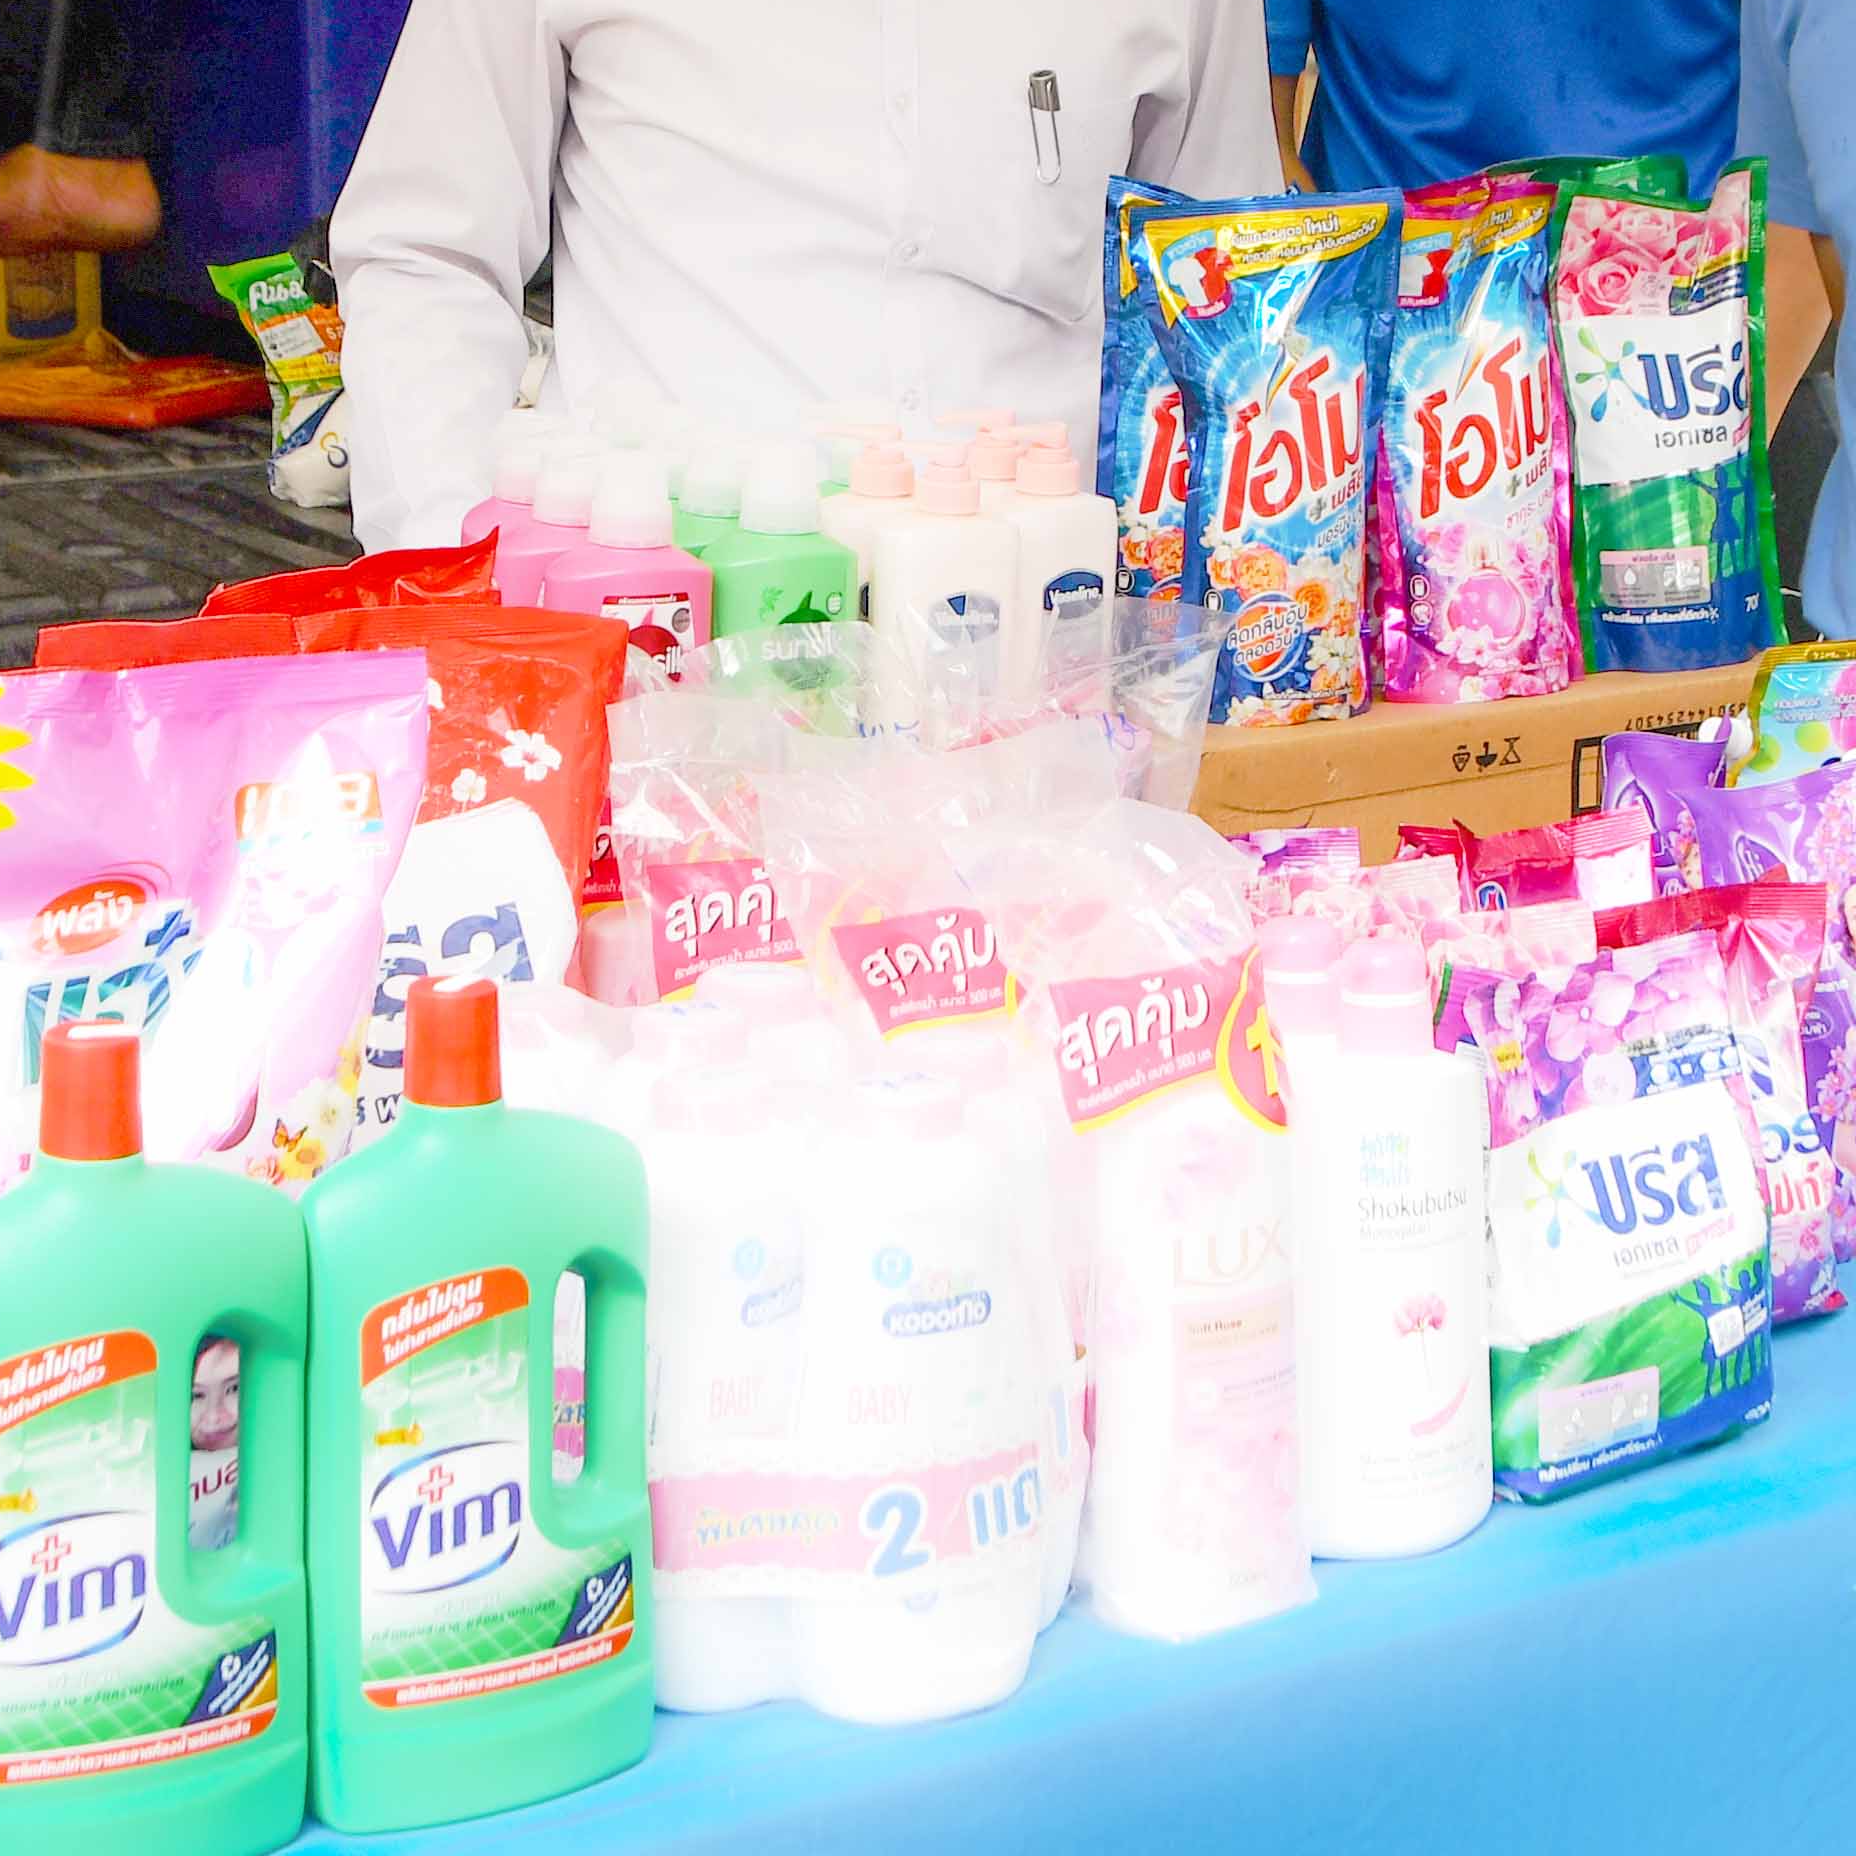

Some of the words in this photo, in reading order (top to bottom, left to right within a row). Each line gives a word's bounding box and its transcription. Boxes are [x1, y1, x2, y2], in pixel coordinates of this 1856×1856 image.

[1414, 336, 1552, 520] โอโม
[1655, 425, 1729, 449] เอกเซล
[1046, 585, 1099, 610] Vaseline
[42, 891, 133, 940] พลัง
[1061, 976, 1210, 1087] สุดคุ้ม
[1357, 1188, 1468, 1224] Shokubutsu
[1580, 1133, 1728, 1236] บรีส
[1172, 1217, 1292, 1289] LUX
[370, 1478, 524, 1570] Vim
[864, 1490, 930, 1578] 2
